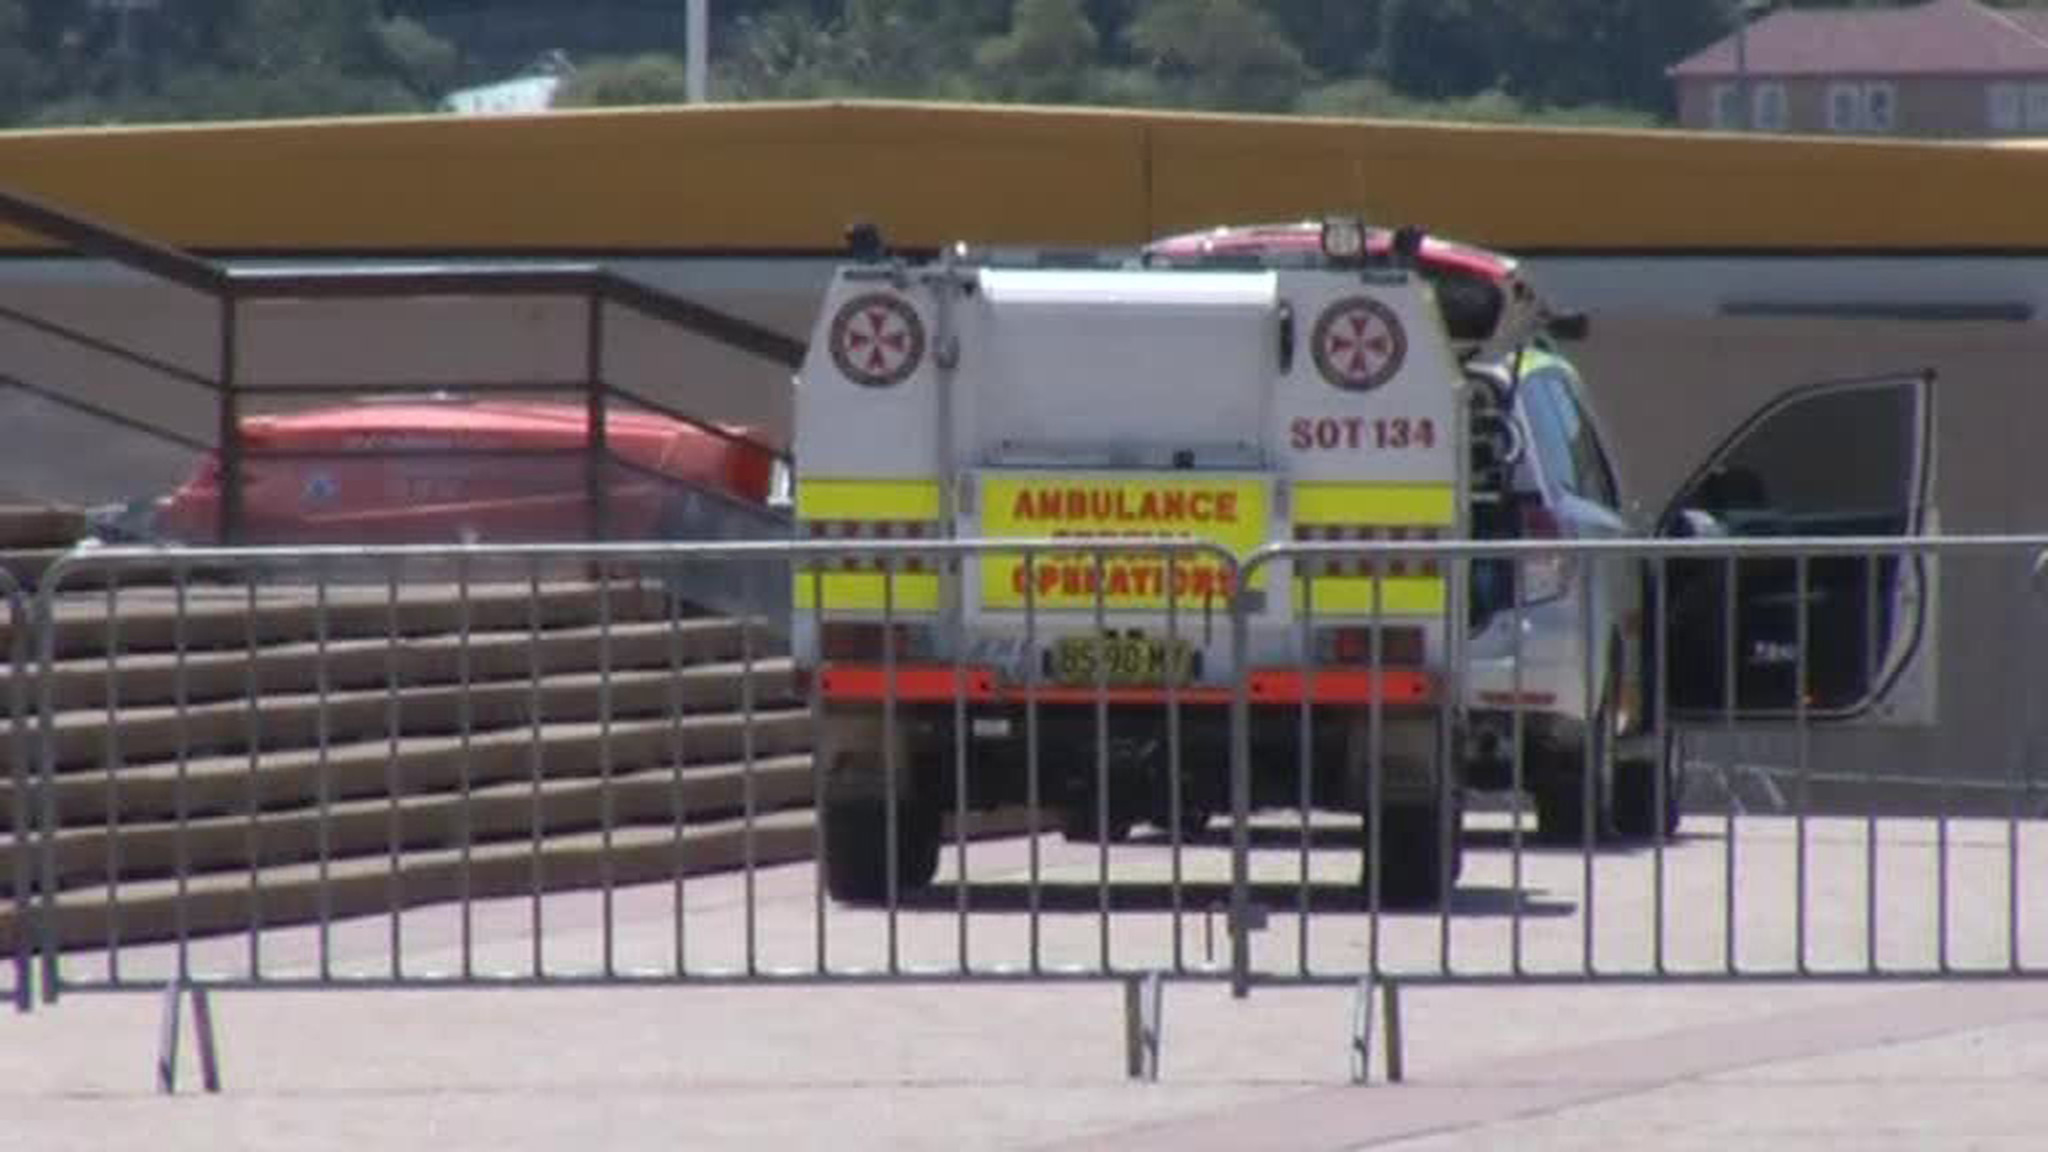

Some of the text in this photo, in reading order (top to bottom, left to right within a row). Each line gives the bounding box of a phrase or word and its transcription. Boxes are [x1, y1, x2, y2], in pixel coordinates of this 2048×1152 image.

[1290, 416, 1436, 451] SOT 134
[1012, 488, 1239, 522] AMBULANCE
